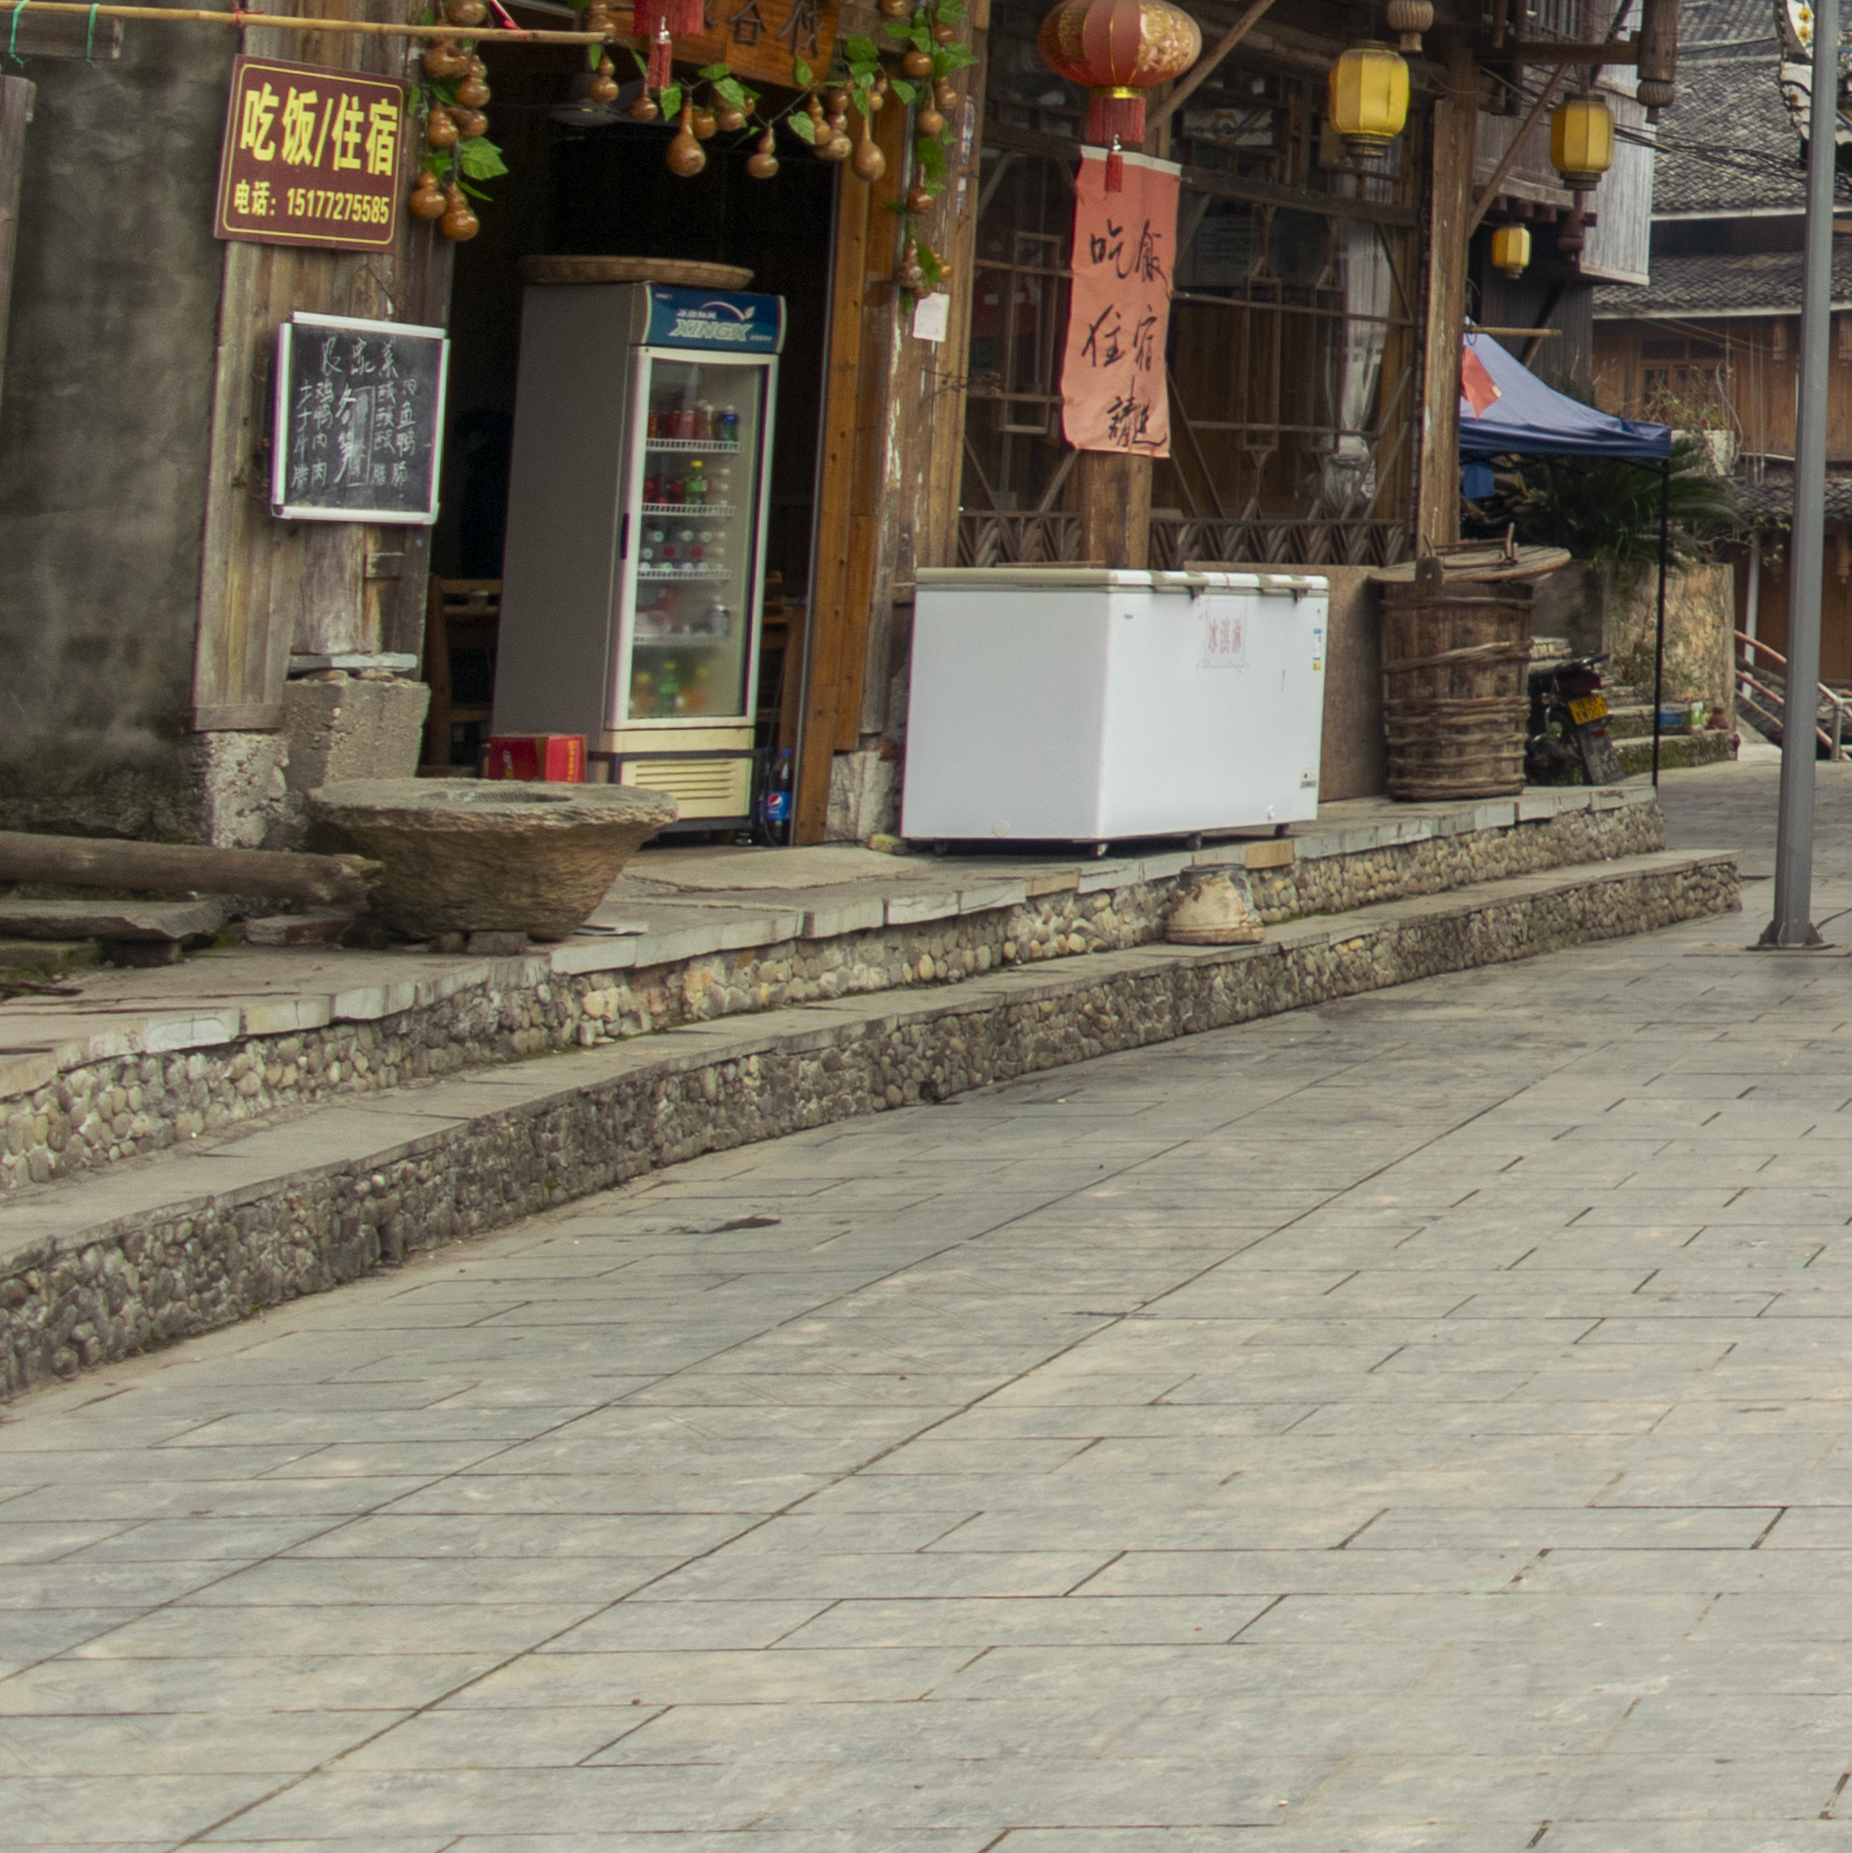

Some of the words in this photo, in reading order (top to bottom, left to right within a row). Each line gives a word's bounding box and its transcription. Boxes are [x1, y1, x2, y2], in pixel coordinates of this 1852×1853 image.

[240, 82, 398, 177] 吃饭/住宿
[1080, 294, 1159, 372] 住宿
